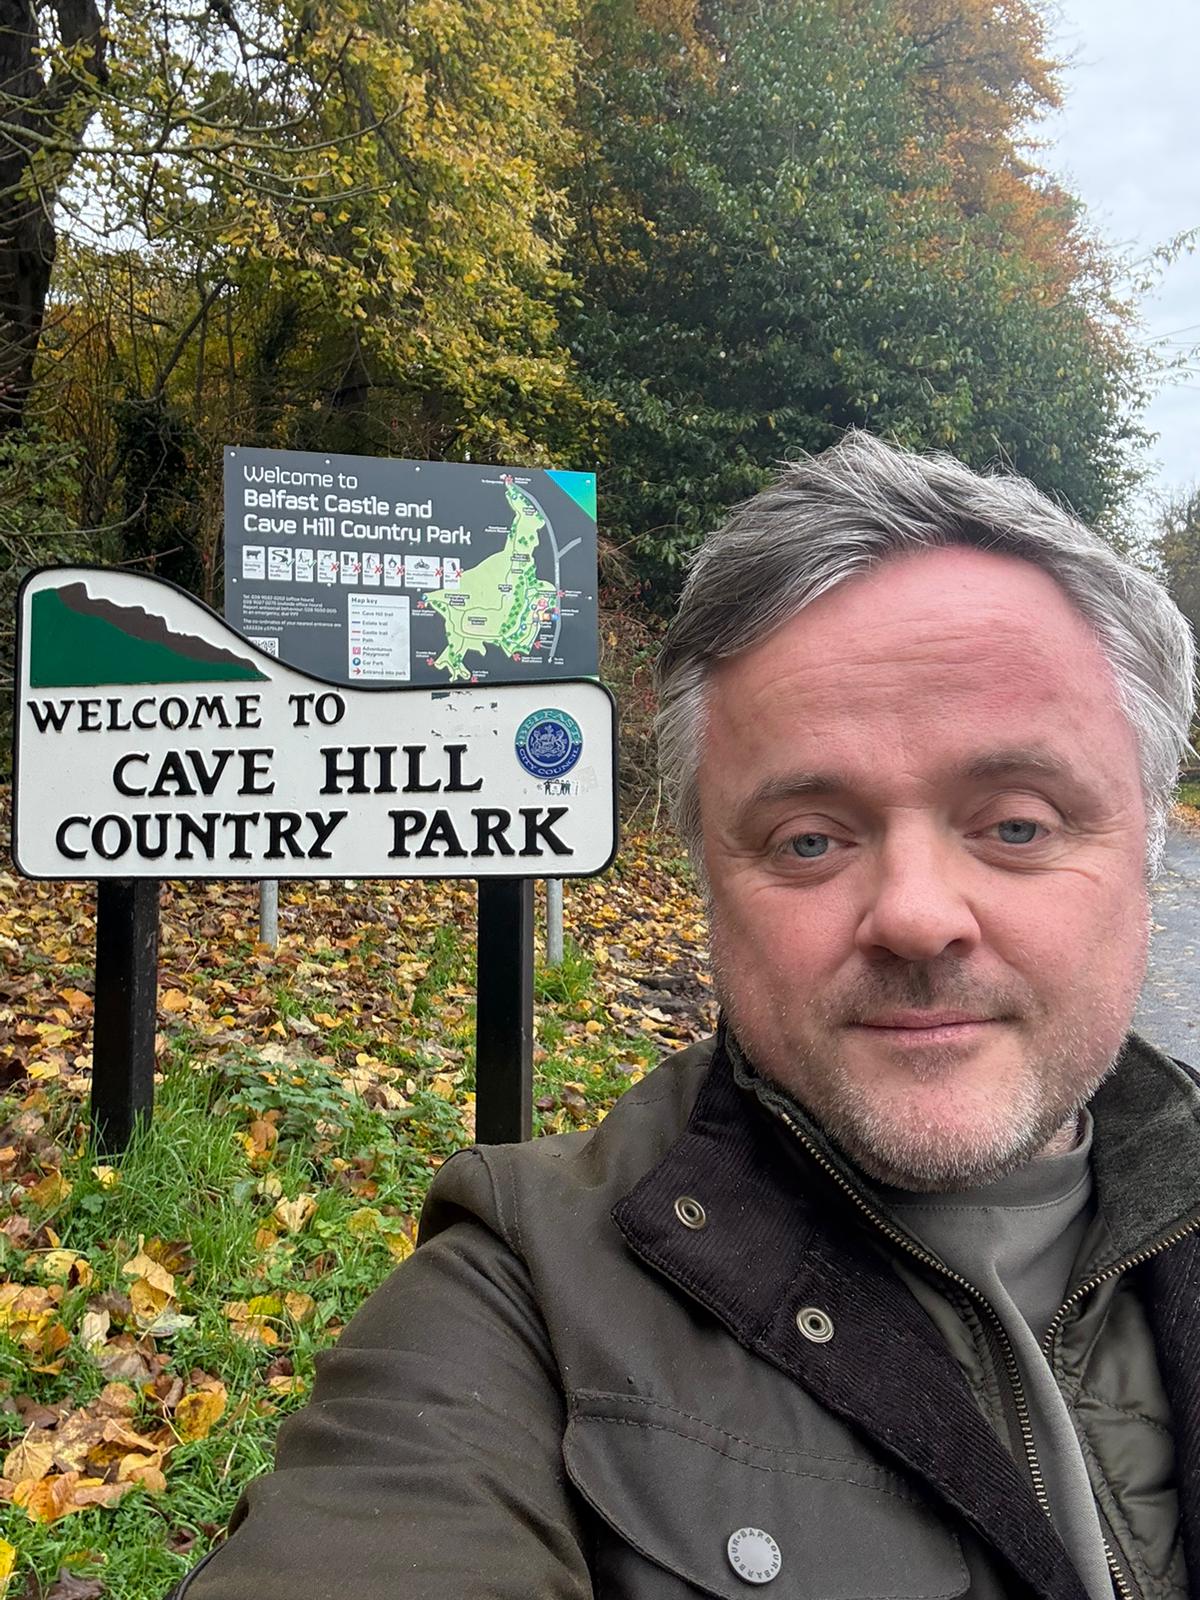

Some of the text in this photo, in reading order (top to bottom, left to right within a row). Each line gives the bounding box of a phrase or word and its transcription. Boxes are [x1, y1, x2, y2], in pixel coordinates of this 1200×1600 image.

[243, 465, 358, 489] Welcome to
[244, 489, 432, 519] Belfast Castle and
[244, 514, 471, 545] Cave Hill Country Park
[27, 689, 345, 733] WELCOME TO
[517, 710, 581, 743] BELFAST
[113, 745, 482, 797] CAVE HILL
[519, 747, 579, 775] CITY COUNCIL
[56, 808, 573, 860] COUNTRY PARK
